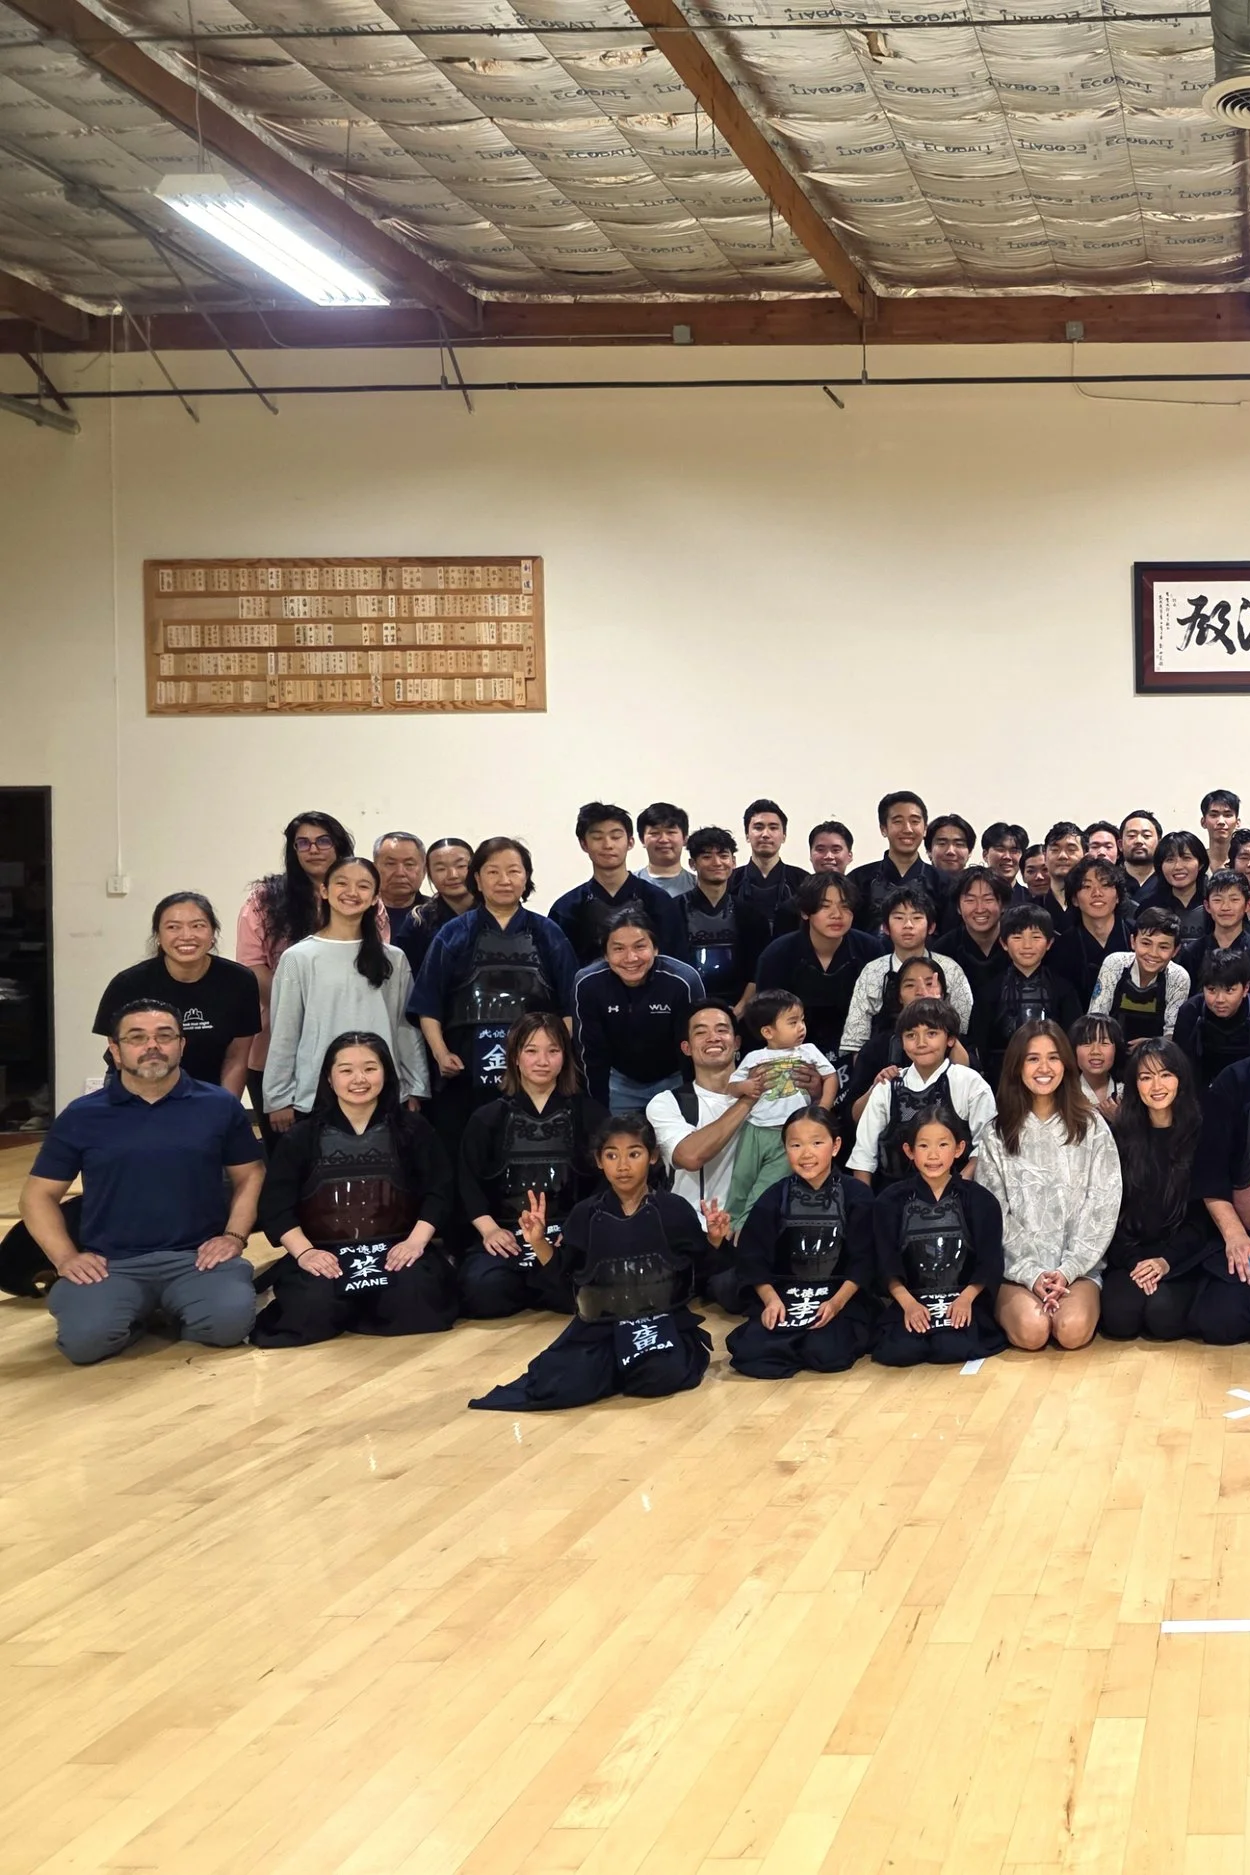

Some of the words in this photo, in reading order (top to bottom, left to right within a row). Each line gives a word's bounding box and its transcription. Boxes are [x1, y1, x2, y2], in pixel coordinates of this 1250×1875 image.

[890, 9, 968, 22] ECOBATT
[792, 83, 866, 94] ECOBATT
[884, 84, 957, 95] ECOBATT
[482, 1044, 507, 1071] 金
[345, 1277, 389, 1291] AYANE
[787, 1298, 821, 1319] 李
